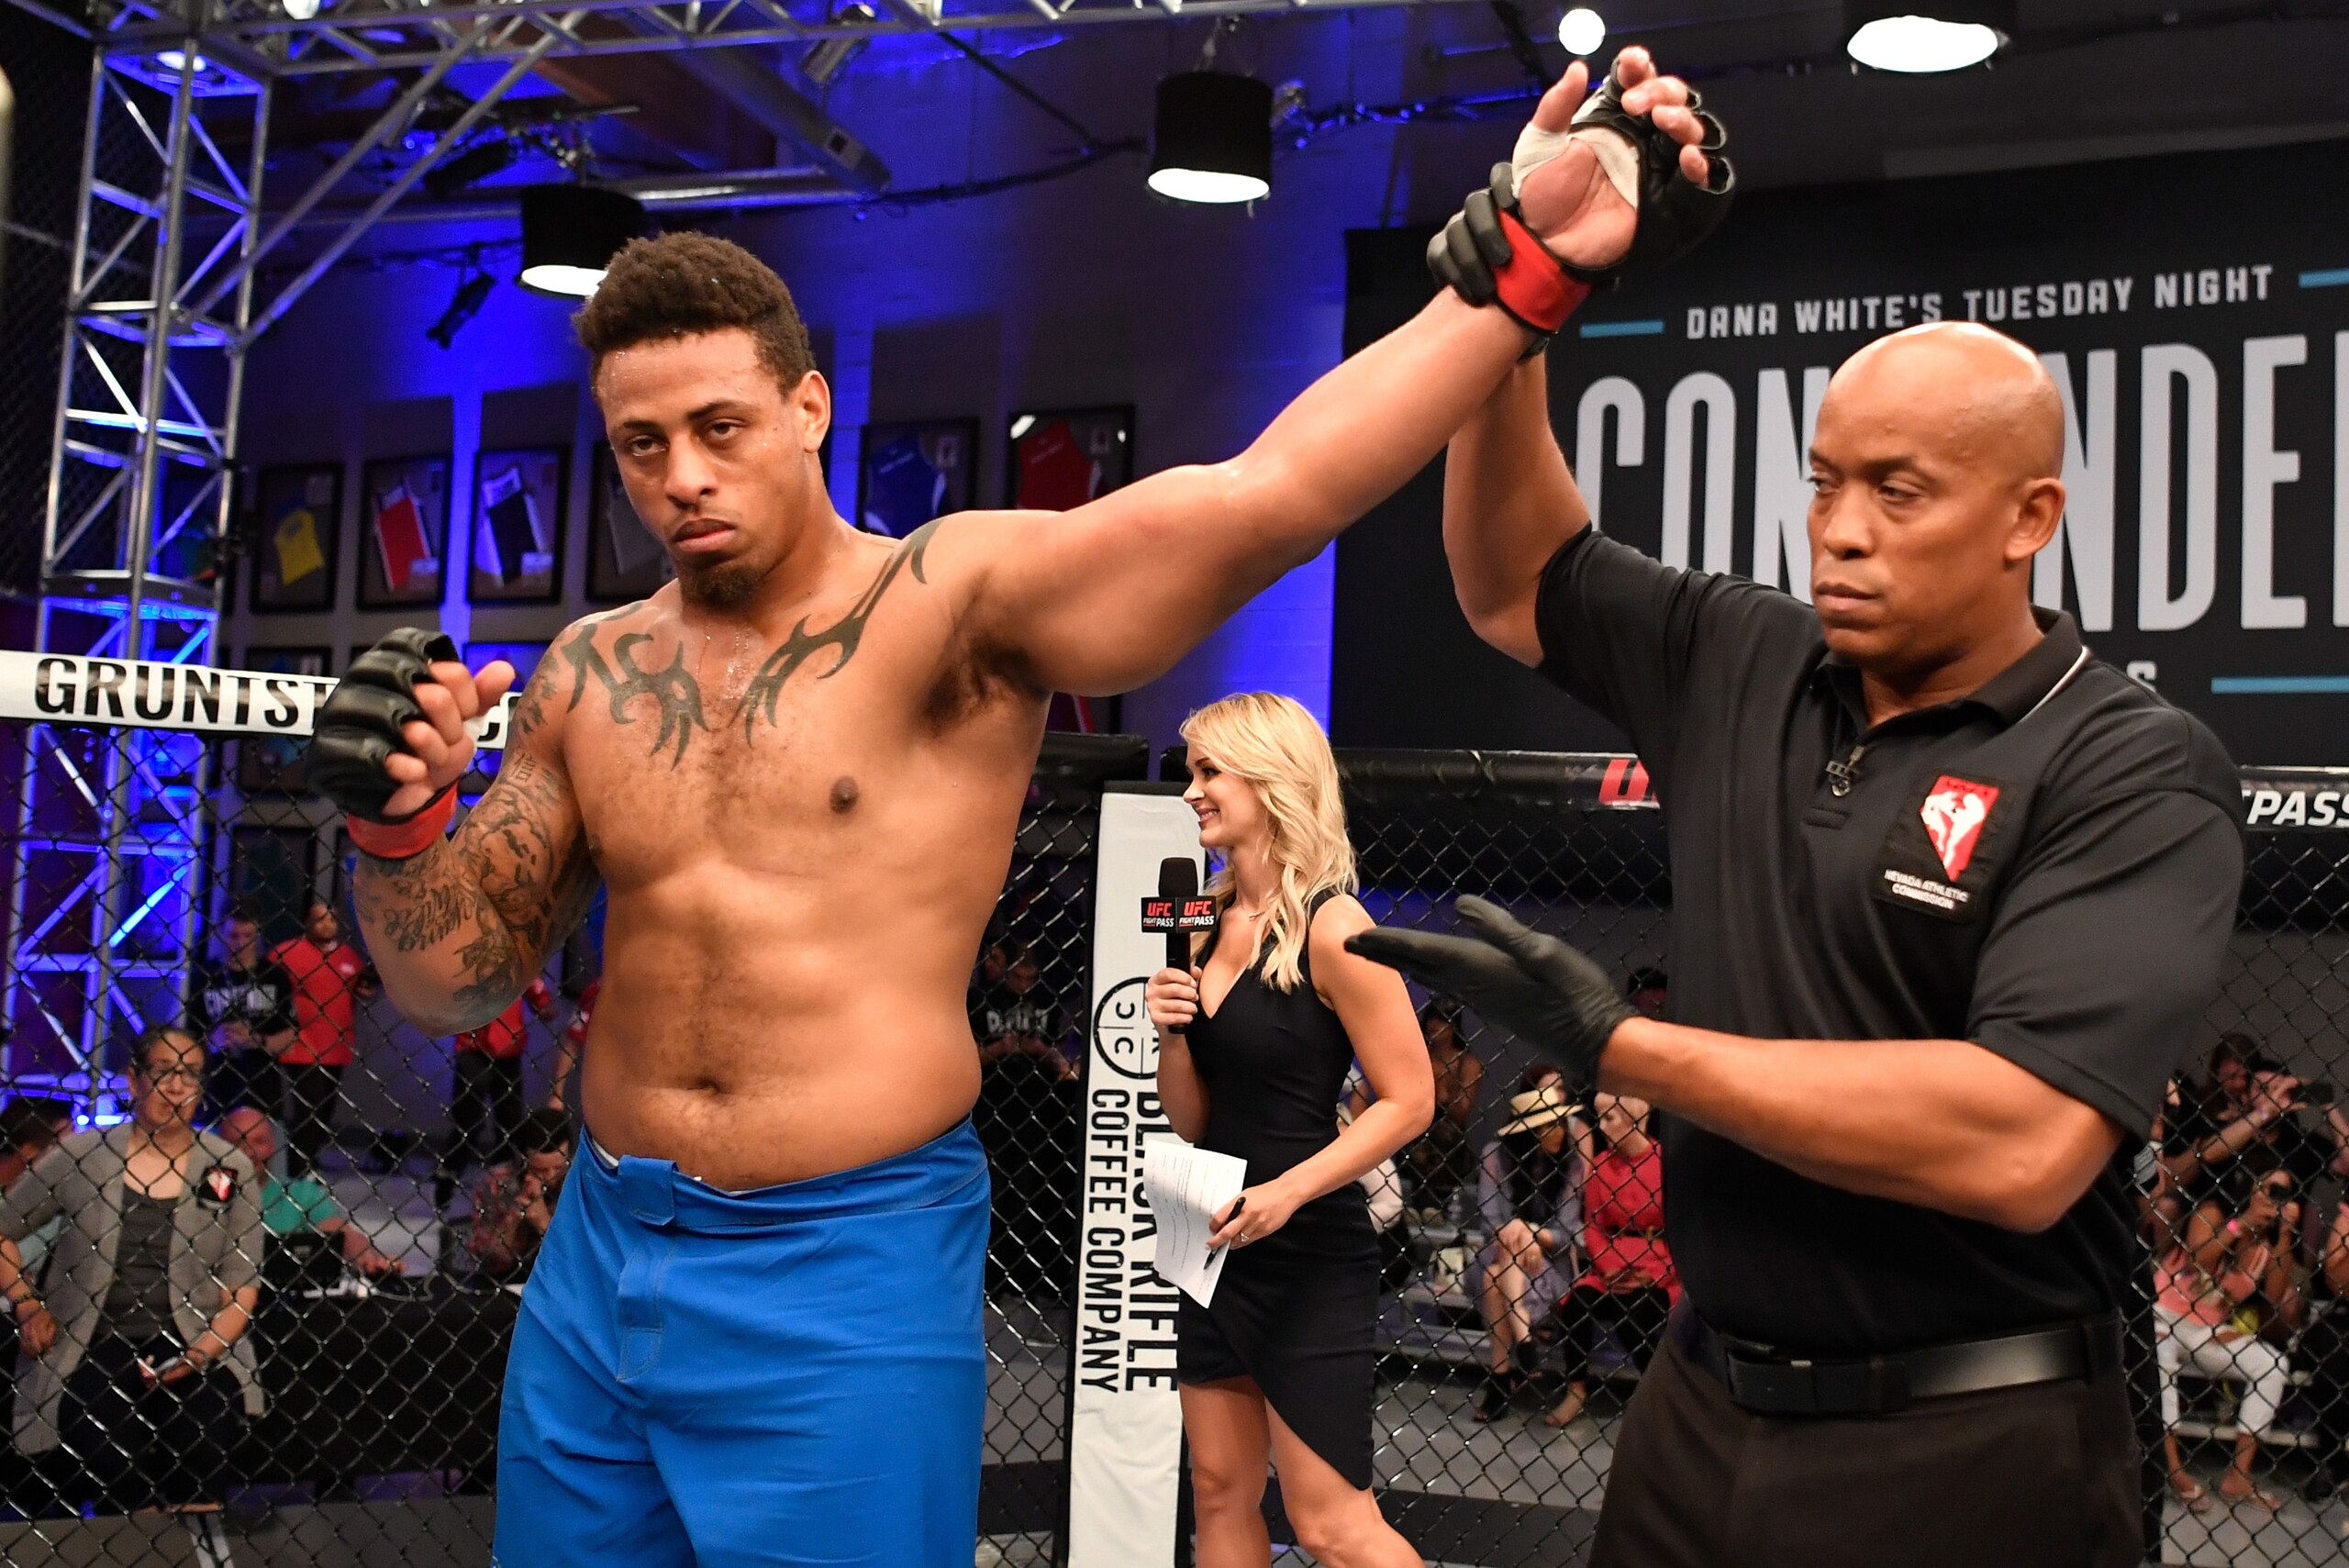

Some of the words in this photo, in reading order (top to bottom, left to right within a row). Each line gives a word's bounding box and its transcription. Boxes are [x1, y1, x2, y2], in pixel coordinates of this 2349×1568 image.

[1687, 303, 1778, 339] DANA
[1794, 292, 1943, 334] WHITE'S
[1963, 277, 2134, 322] TUESDAY
[2154, 264, 2273, 309] NIGHT
[1884, 869, 1922, 889] NEVADA
[1920, 879, 1970, 904] ATHLETIC
[1891, 883, 1955, 910] COMMISSION
[1146, 902, 1173, 917] UFC
[1184, 900, 1212, 916] UFC
[1194, 916, 1215, 927] PASS
[1156, 917, 1174, 928] PASS
[1088, 1088, 1130, 1215] COFFEE
[1081, 1227, 1126, 1394] COMPANY
